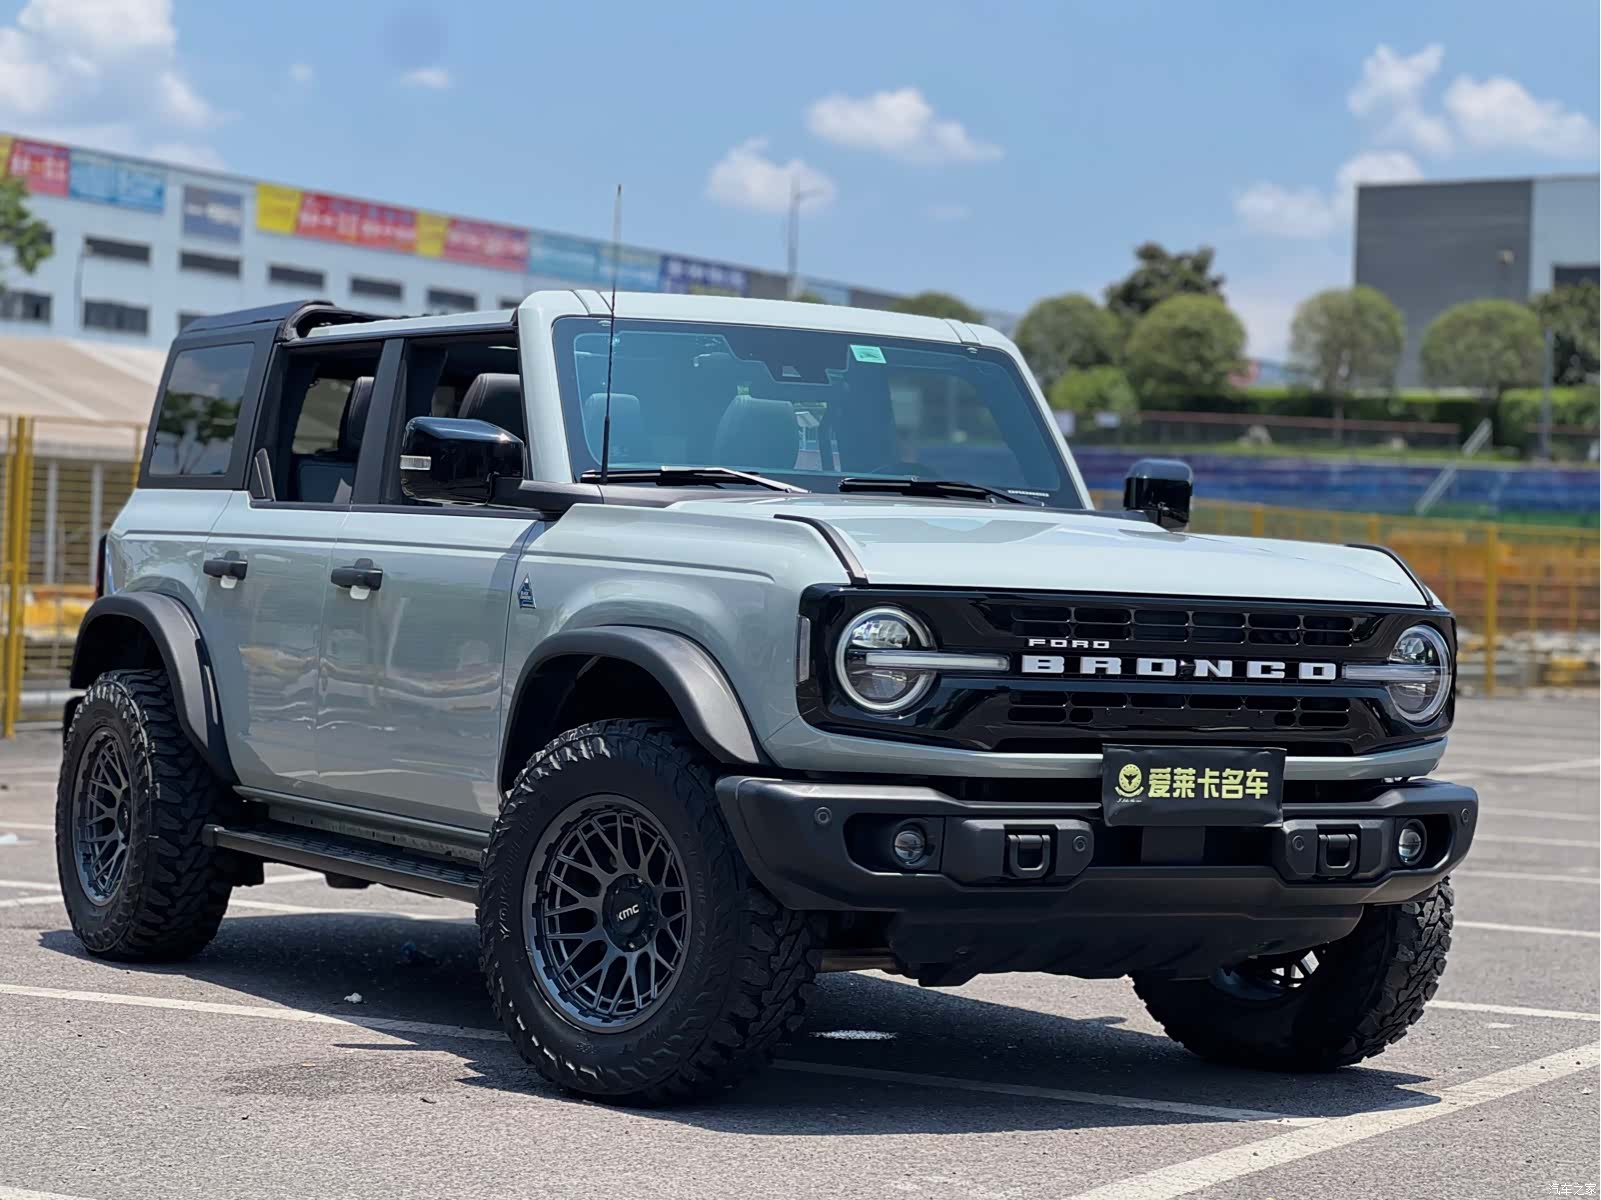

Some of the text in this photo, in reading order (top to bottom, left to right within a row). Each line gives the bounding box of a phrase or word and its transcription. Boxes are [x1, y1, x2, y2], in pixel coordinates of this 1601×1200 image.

[1028, 637, 1111, 650] FORD
[1020, 654, 1338, 681] BRONCO
[1147, 767, 1269, 800] 爱莱卡名车
[616, 903, 640, 922] KMC
